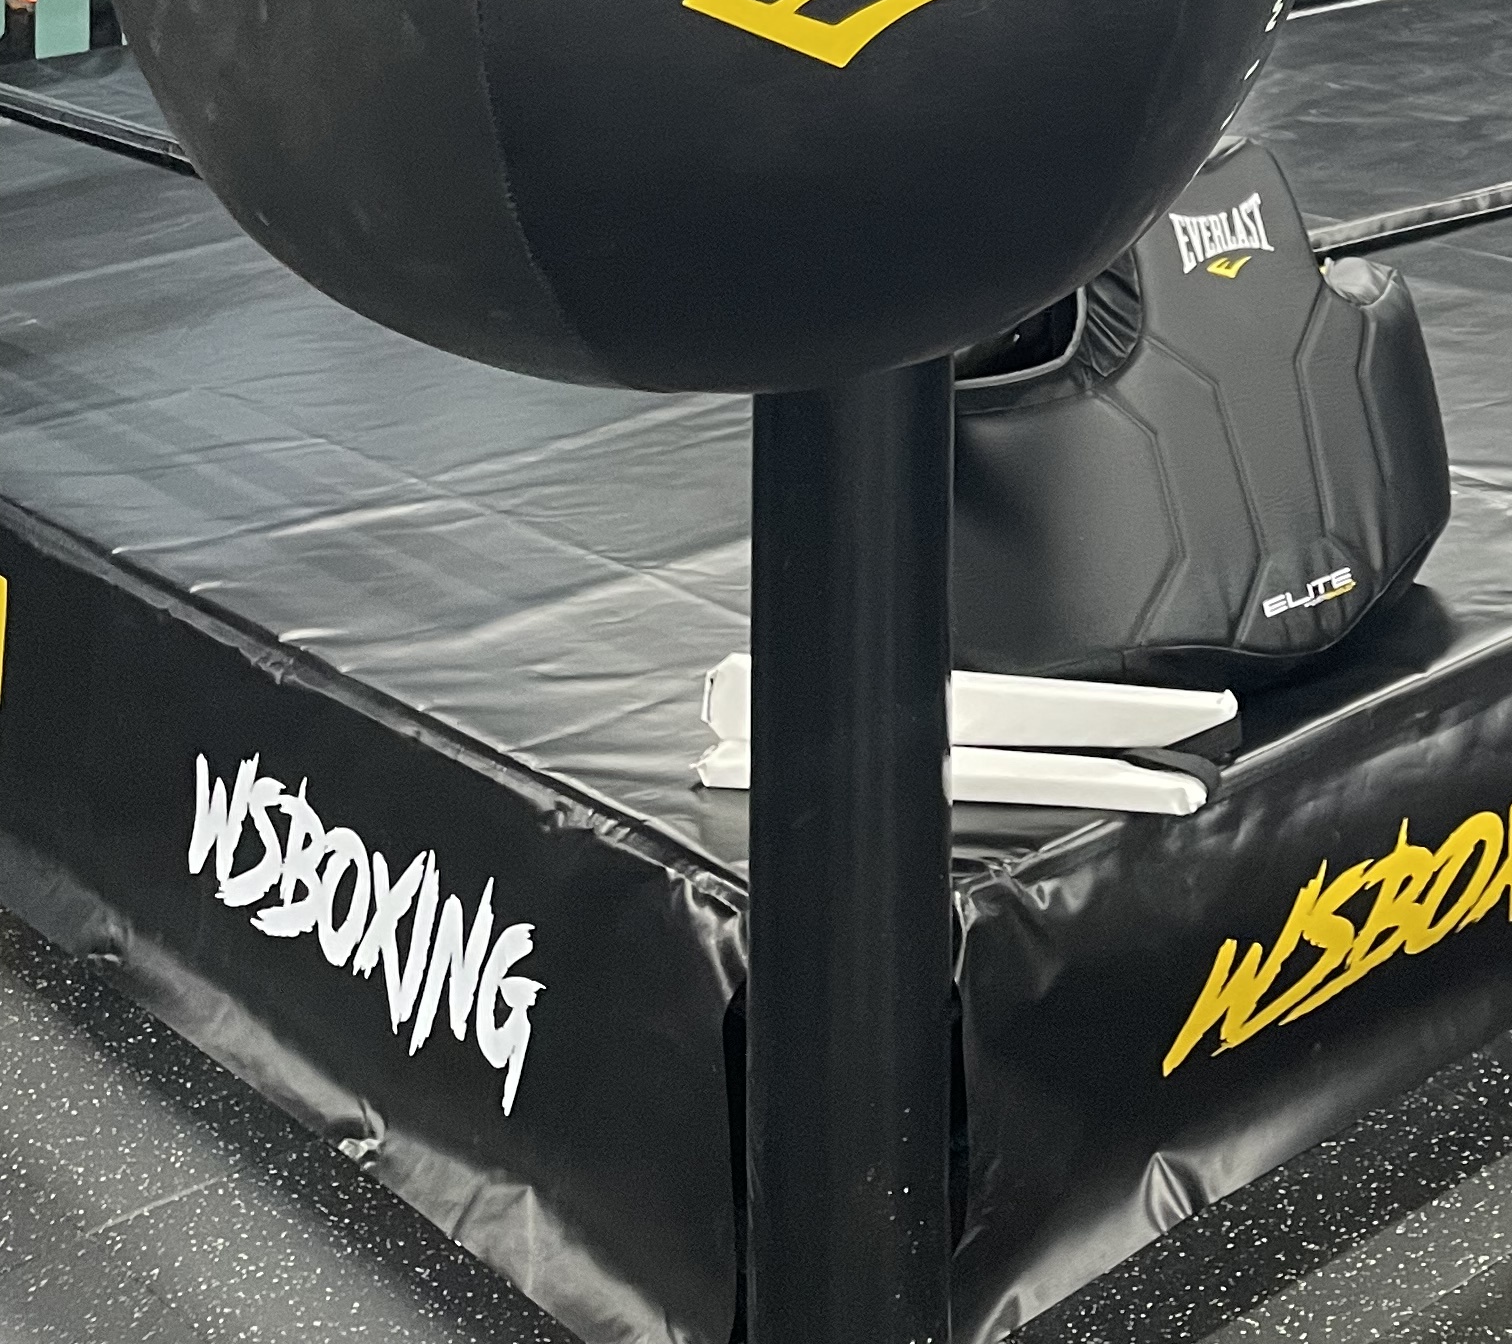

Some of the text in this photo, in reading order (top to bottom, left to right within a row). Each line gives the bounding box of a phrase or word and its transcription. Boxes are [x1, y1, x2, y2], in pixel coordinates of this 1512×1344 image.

[1168, 192, 1275, 274] EVERLAST
[1263, 567, 1353, 618] ELITE
[188, 752, 545, 1116] WSBOXING
